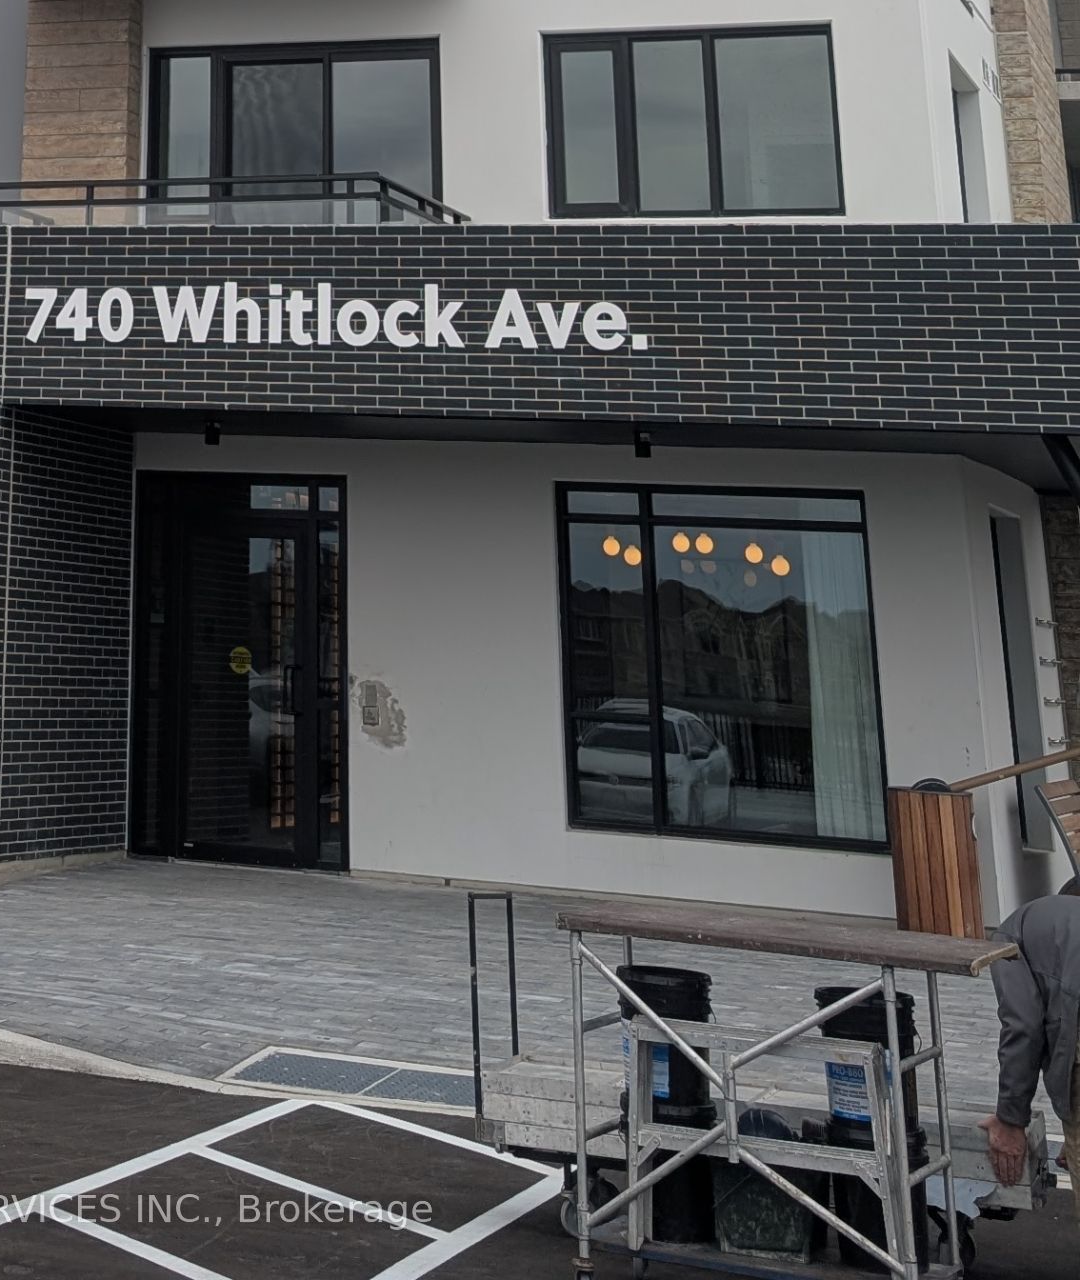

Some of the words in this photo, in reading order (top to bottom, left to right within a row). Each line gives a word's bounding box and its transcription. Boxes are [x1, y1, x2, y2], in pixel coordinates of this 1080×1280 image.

[24, 287, 135, 344] 740
[152, 281, 466, 348] Whitlock
[484, 287, 649, 351] Ave.
